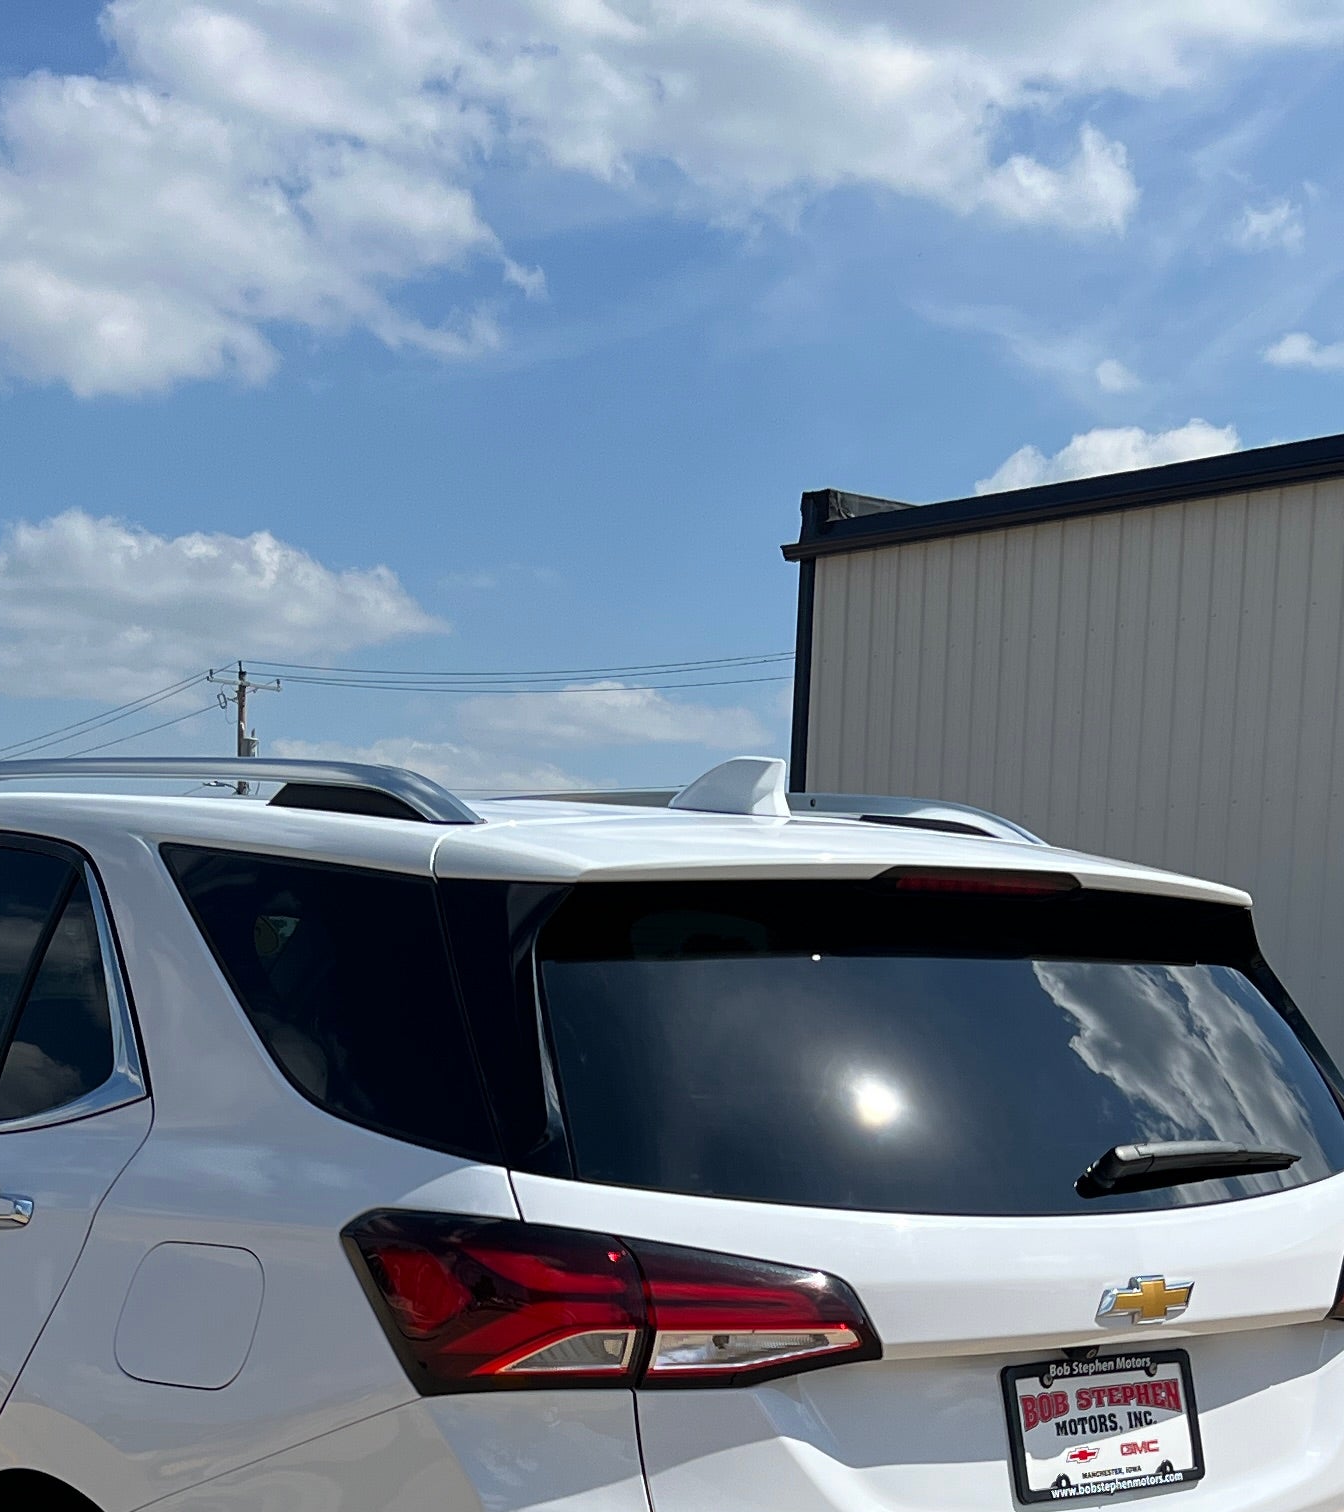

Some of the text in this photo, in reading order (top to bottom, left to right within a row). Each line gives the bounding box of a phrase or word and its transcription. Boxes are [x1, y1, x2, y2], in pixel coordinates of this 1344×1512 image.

[1049, 1356, 1151, 1377] Bob Stephen Motors
[1019, 1378, 1183, 1431] BOB STEPHEN
[1055, 1410, 1157, 1436] MOTORS, INC.
[1120, 1438, 1159, 1456] GMC
[1050, 1471, 1183, 1499] www.bobstephenmotors.com
